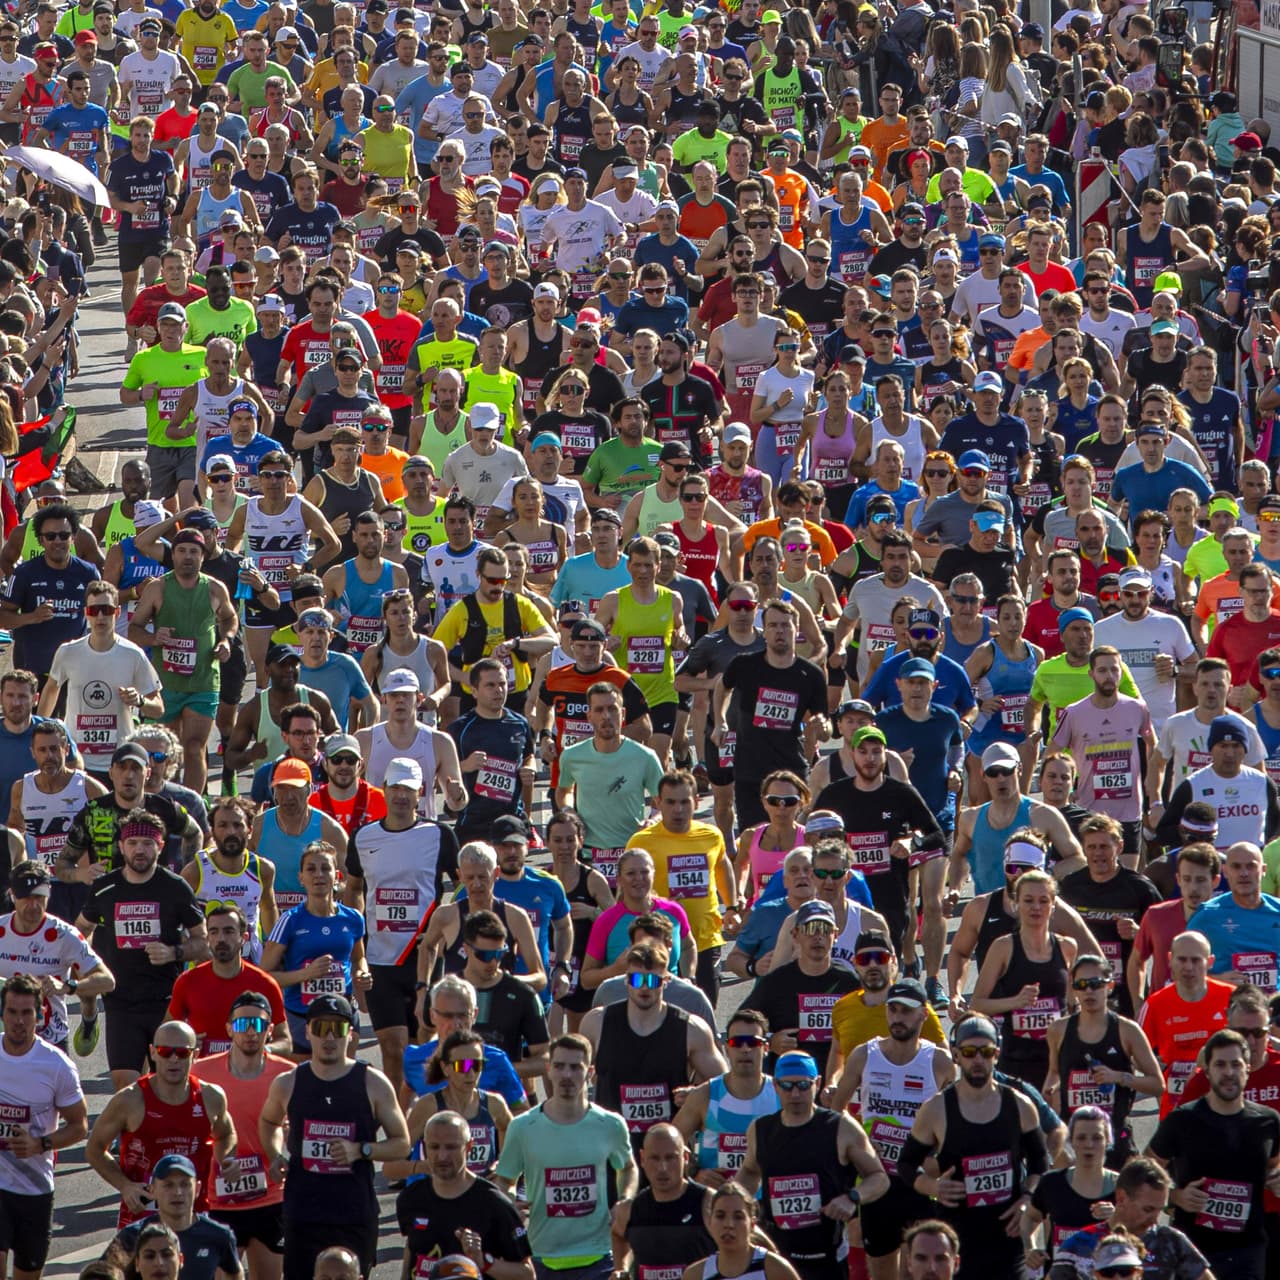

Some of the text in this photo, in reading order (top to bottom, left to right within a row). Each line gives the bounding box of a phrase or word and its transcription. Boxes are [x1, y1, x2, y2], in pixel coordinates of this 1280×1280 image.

[128, 185, 162, 195] Prague
[292, 235, 329, 245] Prague
[843, 263, 866, 274] 2802
[382, 376, 404, 386] 2441
[564, 437, 591, 447] F1631
[779, 435, 798, 445] F140
[817, 469, 846, 480] F1474
[352, 617, 382, 628] RUNCZECH
[351, 631, 378, 644] 2356
[631, 637, 663, 648] RUNCZECH
[167, 651, 191, 664] 2621
[633, 651, 659, 663] 3287
[763, 690, 797, 704] RUNCZECH
[763, 706, 789, 719] 2473
[80, 716, 114, 727] RUNCZECH
[82, 729, 111, 743] 3347
[483, 772, 512, 789] 2493
[1100, 774, 1127, 787] 1625
[851, 834, 888, 846] RUNCZECH
[672, 855, 706, 868] RUNCZECH
[855, 849, 884, 862] 1840
[675, 872, 704, 887] 1544
[215, 885, 248, 894] FONTANA
[379, 890, 415, 901] RUNCZECH
[118, 904, 155, 915] RUNCZECH
[387, 906, 407, 919] 179
[122, 922, 151, 935] 1146
[31, 955, 61, 966] KLAUN
[807, 1014, 832, 1028] 667
[625, 1085, 665, 1098] RUNCZECH
[629, 1103, 663, 1120] 2465
[309, 1123, 350, 1137] RUNCZECH
[968, 1154, 1009, 1170] RUNCZECH
[549, 1168, 592, 1182] RUNCZECH
[223, 1175, 259, 1193] 3219
[774, 1178, 814, 1192] RUNCZECH
[973, 1173, 1007, 1191] 2367
[552, 1186, 590, 1203] 3323
[779, 1196, 813, 1214] 1232
[1205, 1203, 1243, 1217] 2099
